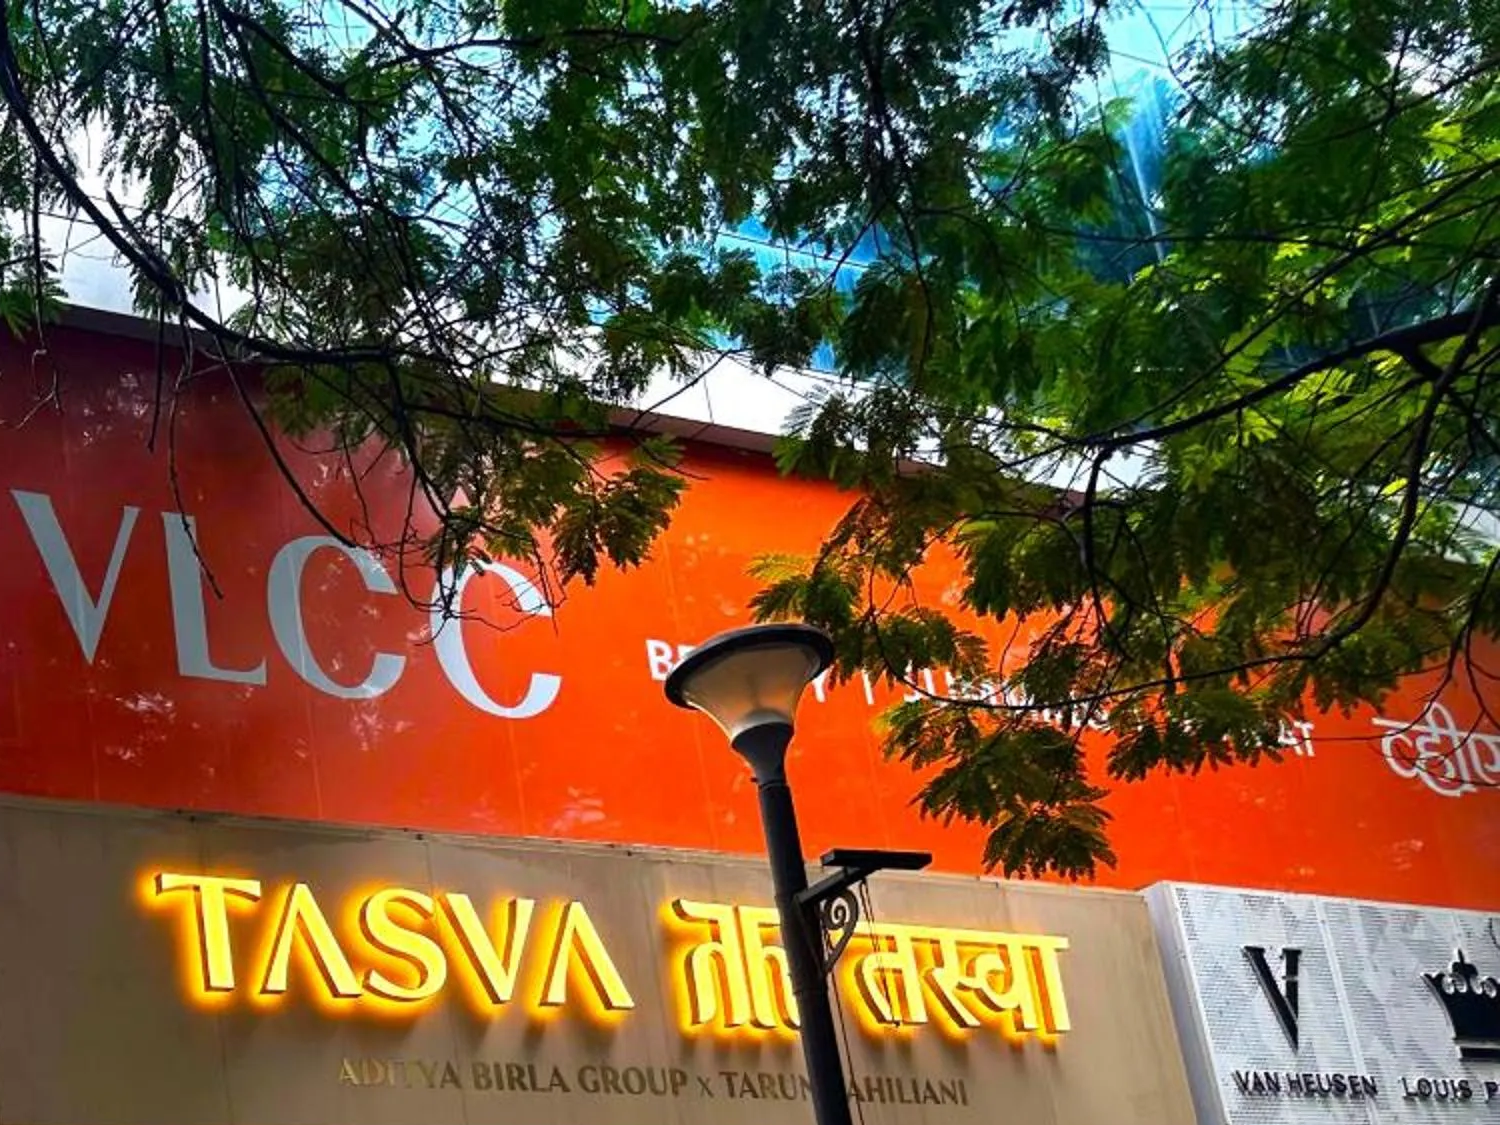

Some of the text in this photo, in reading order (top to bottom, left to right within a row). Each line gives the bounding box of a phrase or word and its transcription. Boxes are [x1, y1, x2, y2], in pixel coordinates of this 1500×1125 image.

[10, 488, 562, 719] VLCC
[154, 872, 634, 1010] TASVA
[338, 1056, 462, 1094] ADITYA
[472, 1062, 571, 1095] BIRLA
[577, 1065, 689, 1099] GROUP
[846, 1075, 970, 1107] AHILIANI
[1233, 1070, 1379, 1098] VAN HEUSEN
[1401, 1077, 1473, 1100] LOUIS
